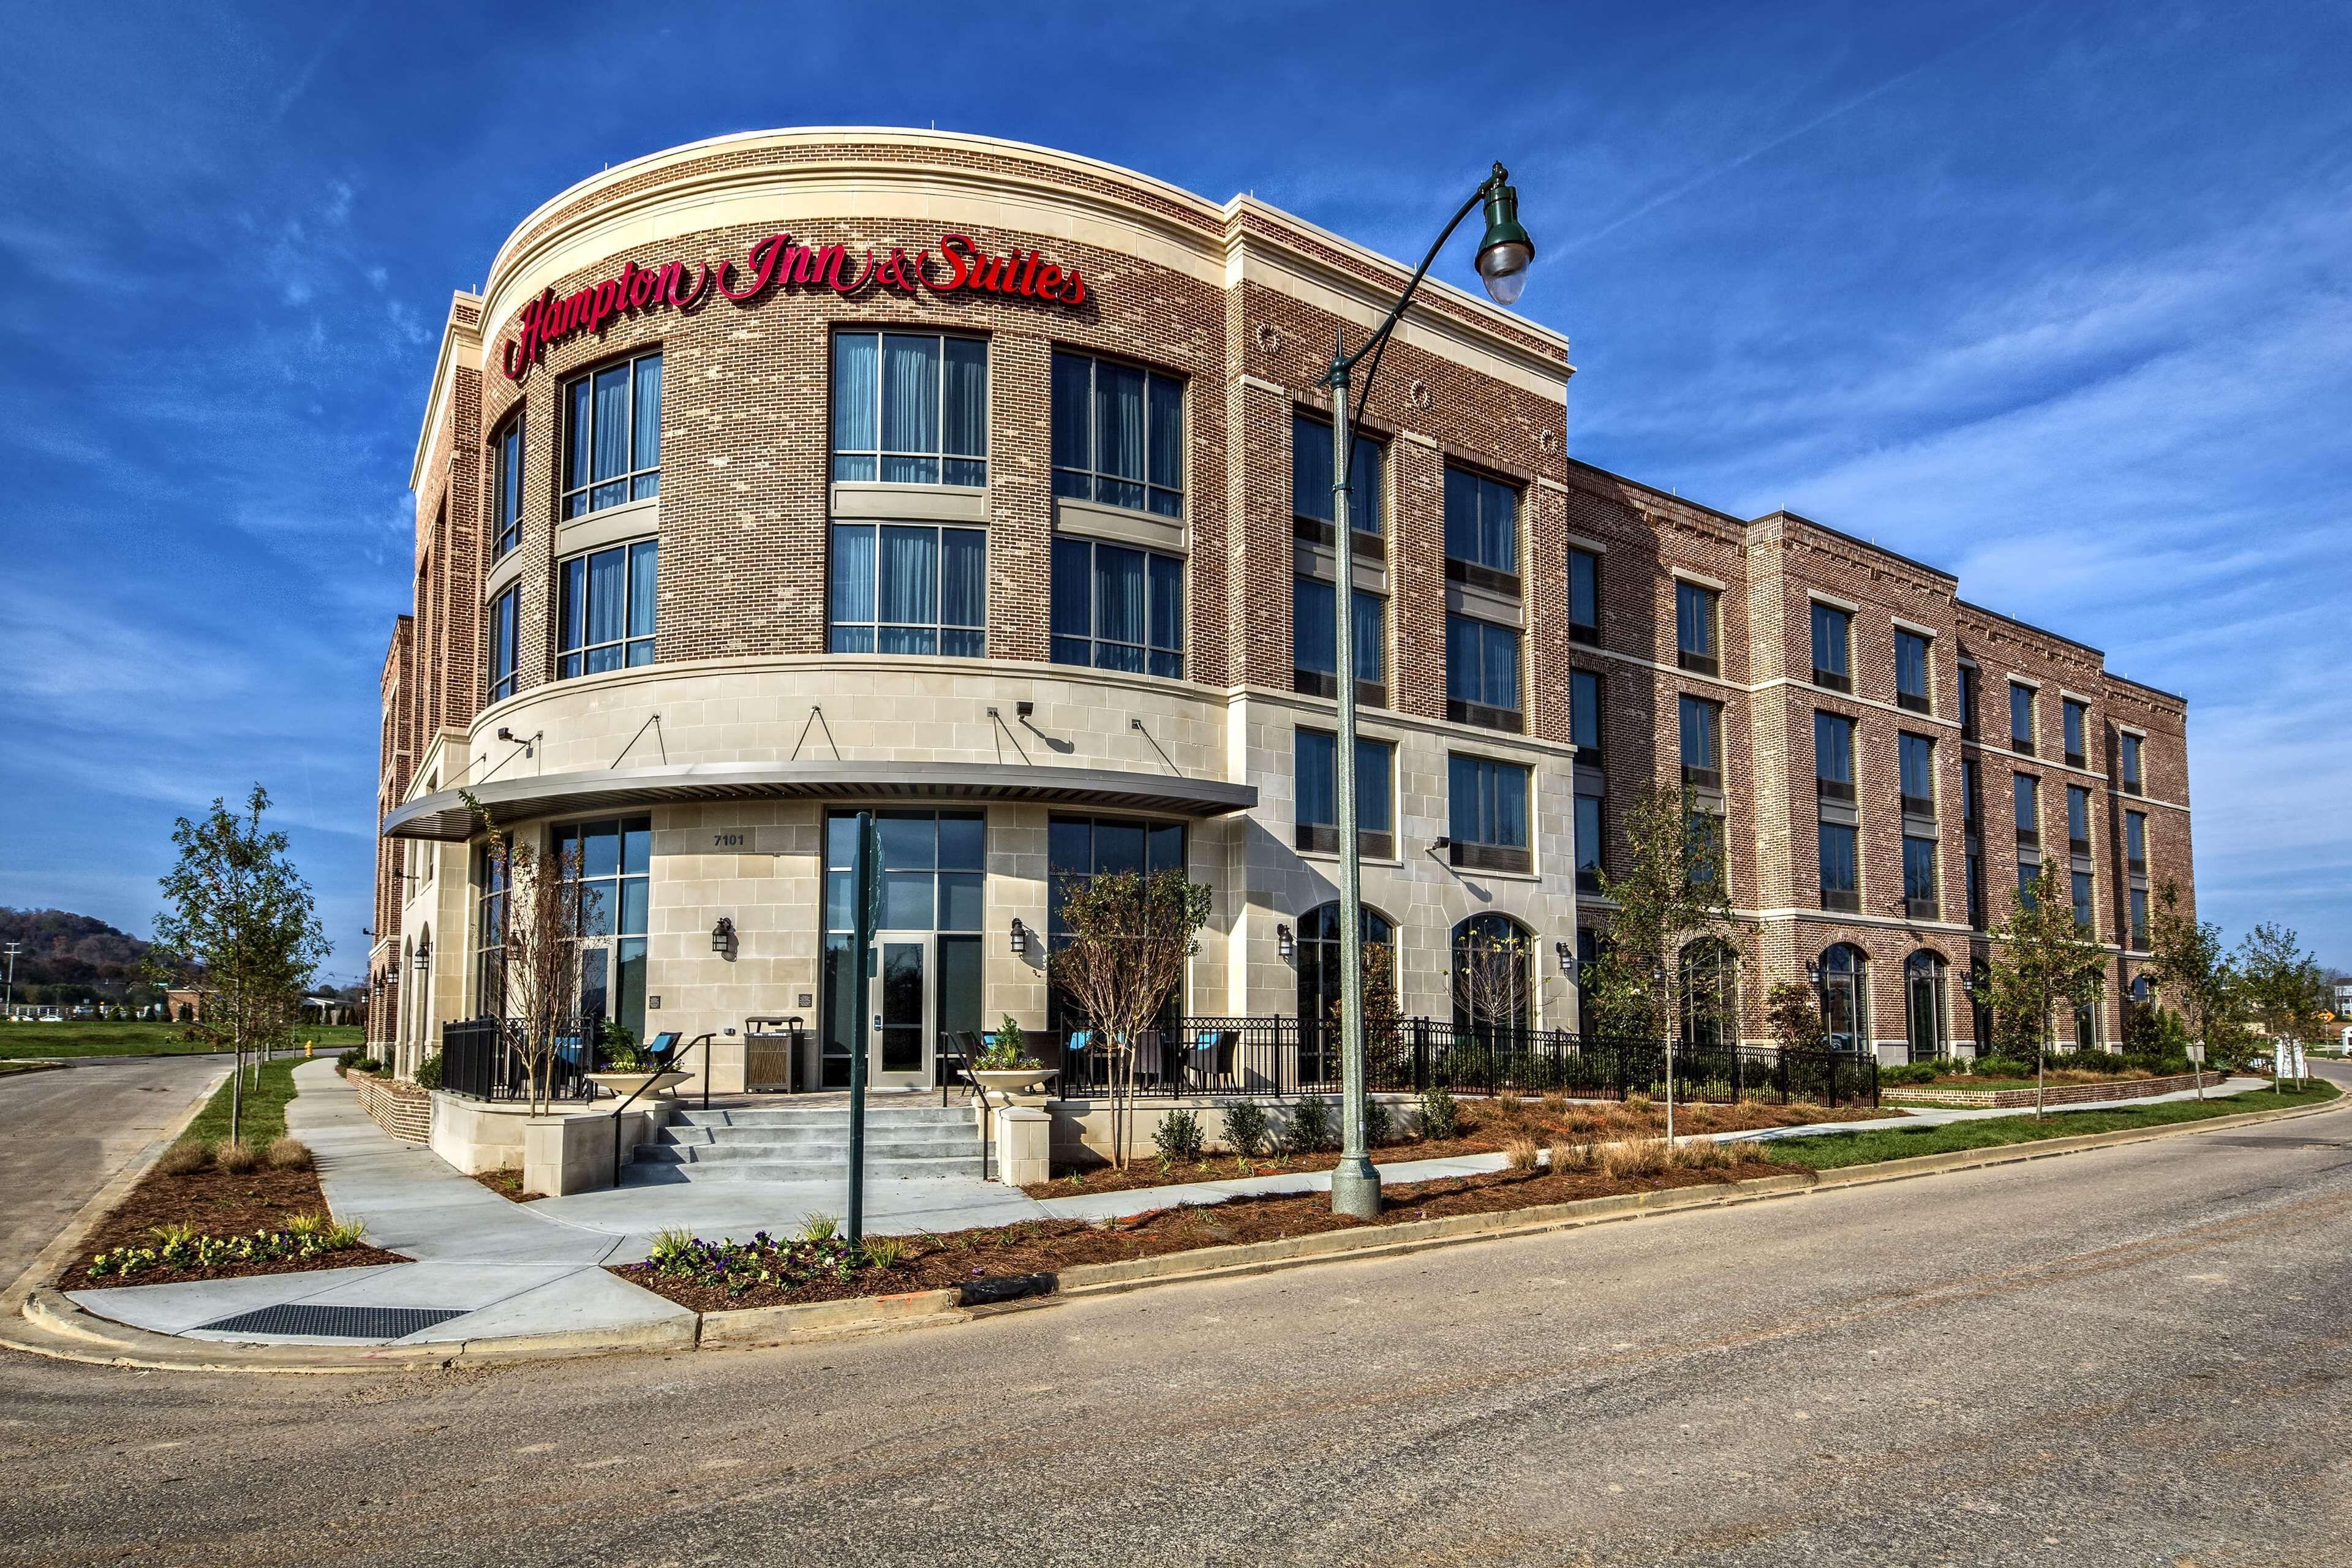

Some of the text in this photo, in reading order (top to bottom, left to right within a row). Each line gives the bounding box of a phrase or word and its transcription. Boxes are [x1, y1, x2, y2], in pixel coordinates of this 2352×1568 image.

[503, 232, 1087, 380] Hampton Inn & Suites
[714, 834, 744, 846] 7101
